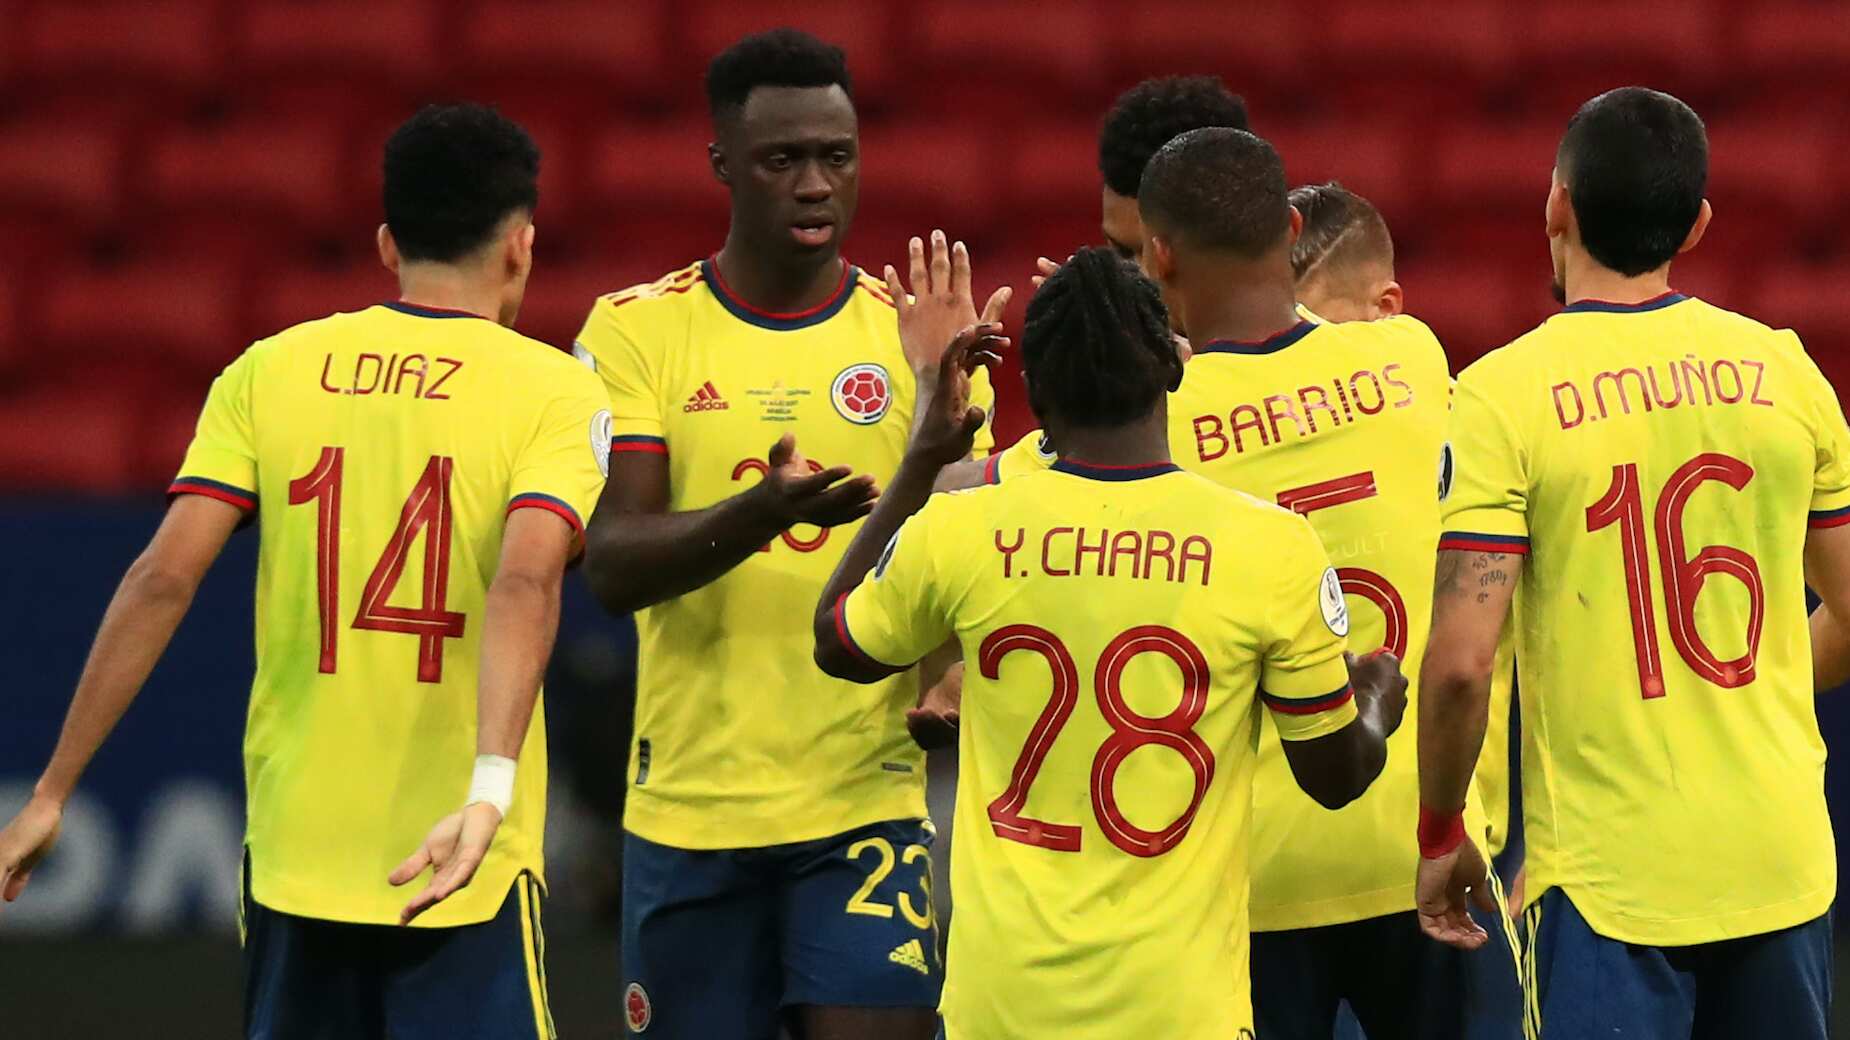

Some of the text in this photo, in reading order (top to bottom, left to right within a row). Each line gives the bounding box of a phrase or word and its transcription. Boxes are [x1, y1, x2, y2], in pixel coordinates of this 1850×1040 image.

[319, 352, 464, 400] L.DIAZ
[683, 399, 729, 413] adidas
[1192, 363, 1413, 463] BARRIOS
[1551, 353, 1774, 430] D.MUÑOZ
[288, 446, 467, 684] 14
[1041, 527, 1213, 586] CHARA
[1585, 452, 1765, 700] 16
[978, 623, 1216, 858] 28
[846, 836, 933, 930] 23
